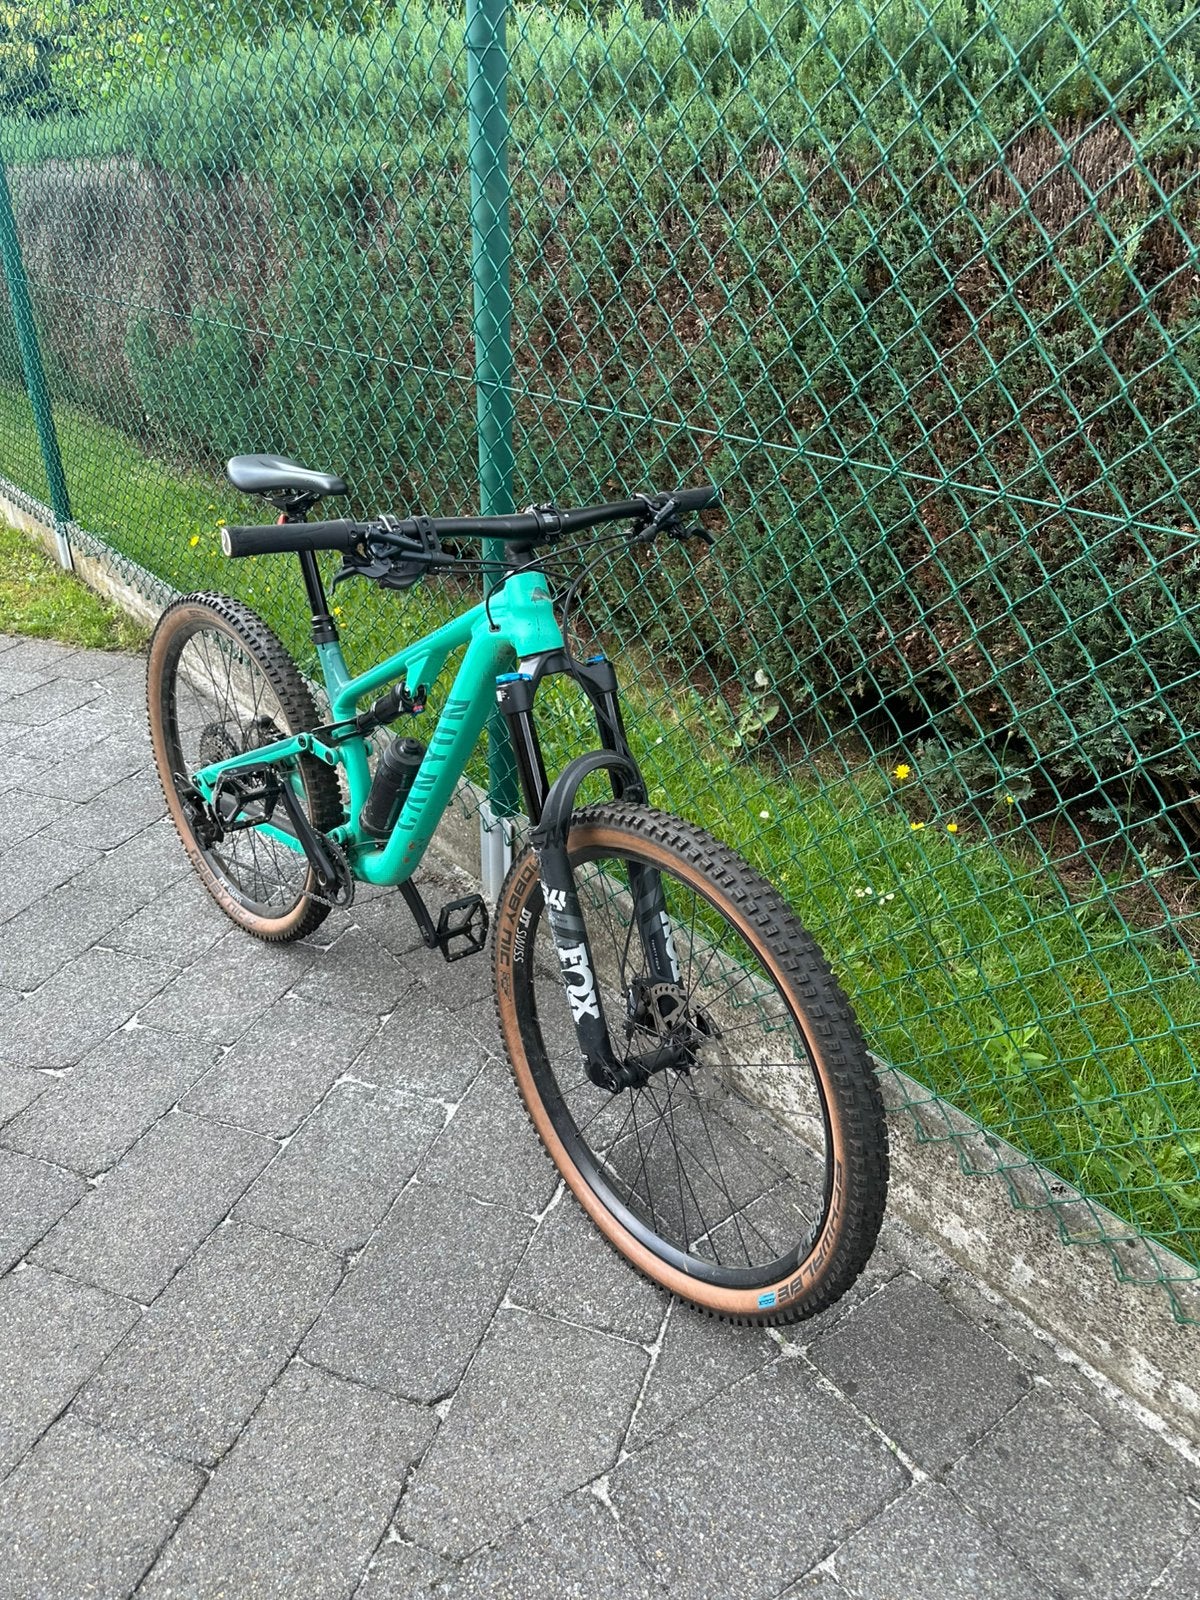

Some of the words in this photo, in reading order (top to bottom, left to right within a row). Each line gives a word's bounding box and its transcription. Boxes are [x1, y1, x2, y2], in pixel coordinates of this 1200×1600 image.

[397, 699, 471, 831] CANYON
[500, 926, 513, 967] NIC
[513, 927, 527, 963] SWISS
[519, 906, 532, 928] DT
[558, 943, 600, 1024] FOX
[777, 1160, 842, 1303] SCHWALBE
